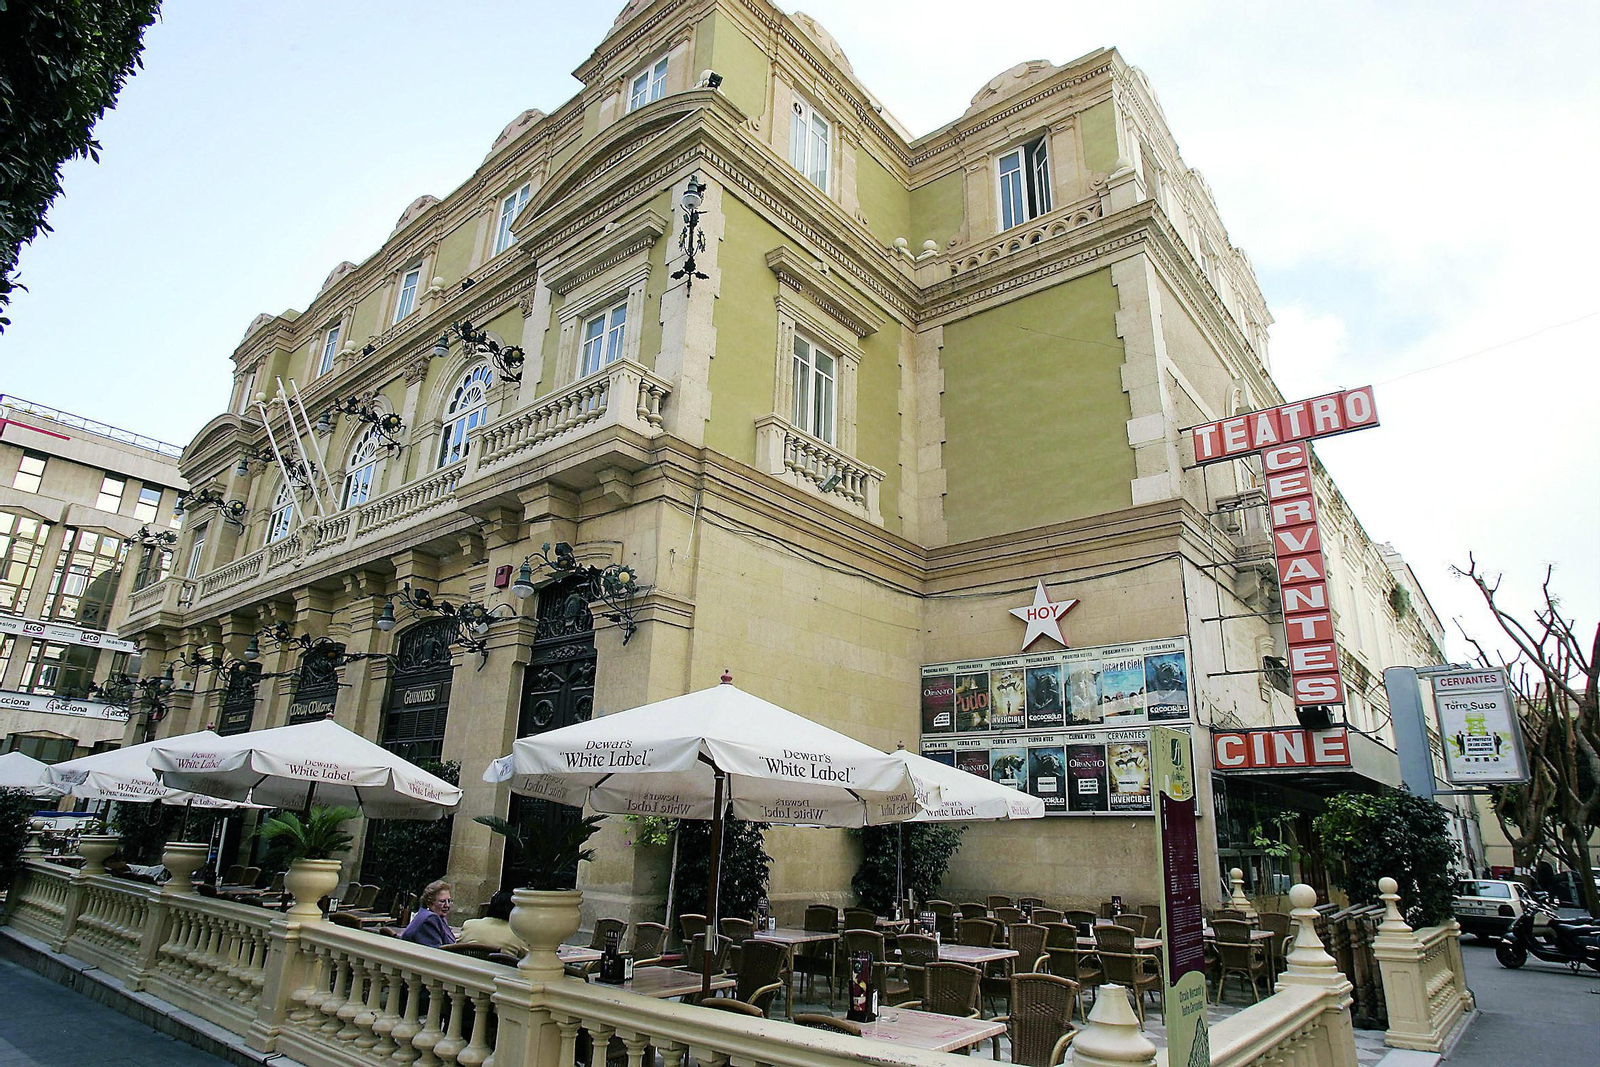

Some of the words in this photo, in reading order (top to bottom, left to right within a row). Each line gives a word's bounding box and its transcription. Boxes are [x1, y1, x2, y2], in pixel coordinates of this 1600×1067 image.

[1195, 391, 1372, 458] TEATRO
[1265, 446, 1338, 703] CERVANTES
[1027, 605, 1059, 621] HOY
[82, 633, 99, 641] LICO
[106, 639, 128, 647] leasing
[1440, 674, 1497, 687] CERVANTES
[404, 688, 436, 705] GUINNESS
[0, 698, 31, 707] cciona
[1470, 702, 1497, 710] Suso
[55, 703, 88, 713] acciona
[1149, 705, 1188, 714] COCODRILO
[991, 715, 1025, 724] INVENCIBLE
[1028, 713, 1063, 721] COCODRILO
[1108, 731, 1146, 740] CERVANTES
[586, 740, 632, 750] Dewar's
[1216, 727, 1347, 767] CINE
[559, 751, 605, 768] "White
[608, 748, 654, 767] Label"
[783, 750, 832, 763] Dewar's
[304, 759, 339, 769] Dewar's
[758, 755, 807, 778] "White
[810, 764, 856, 784] Label"
[1111, 795, 1151, 804] INVENCIBLE
